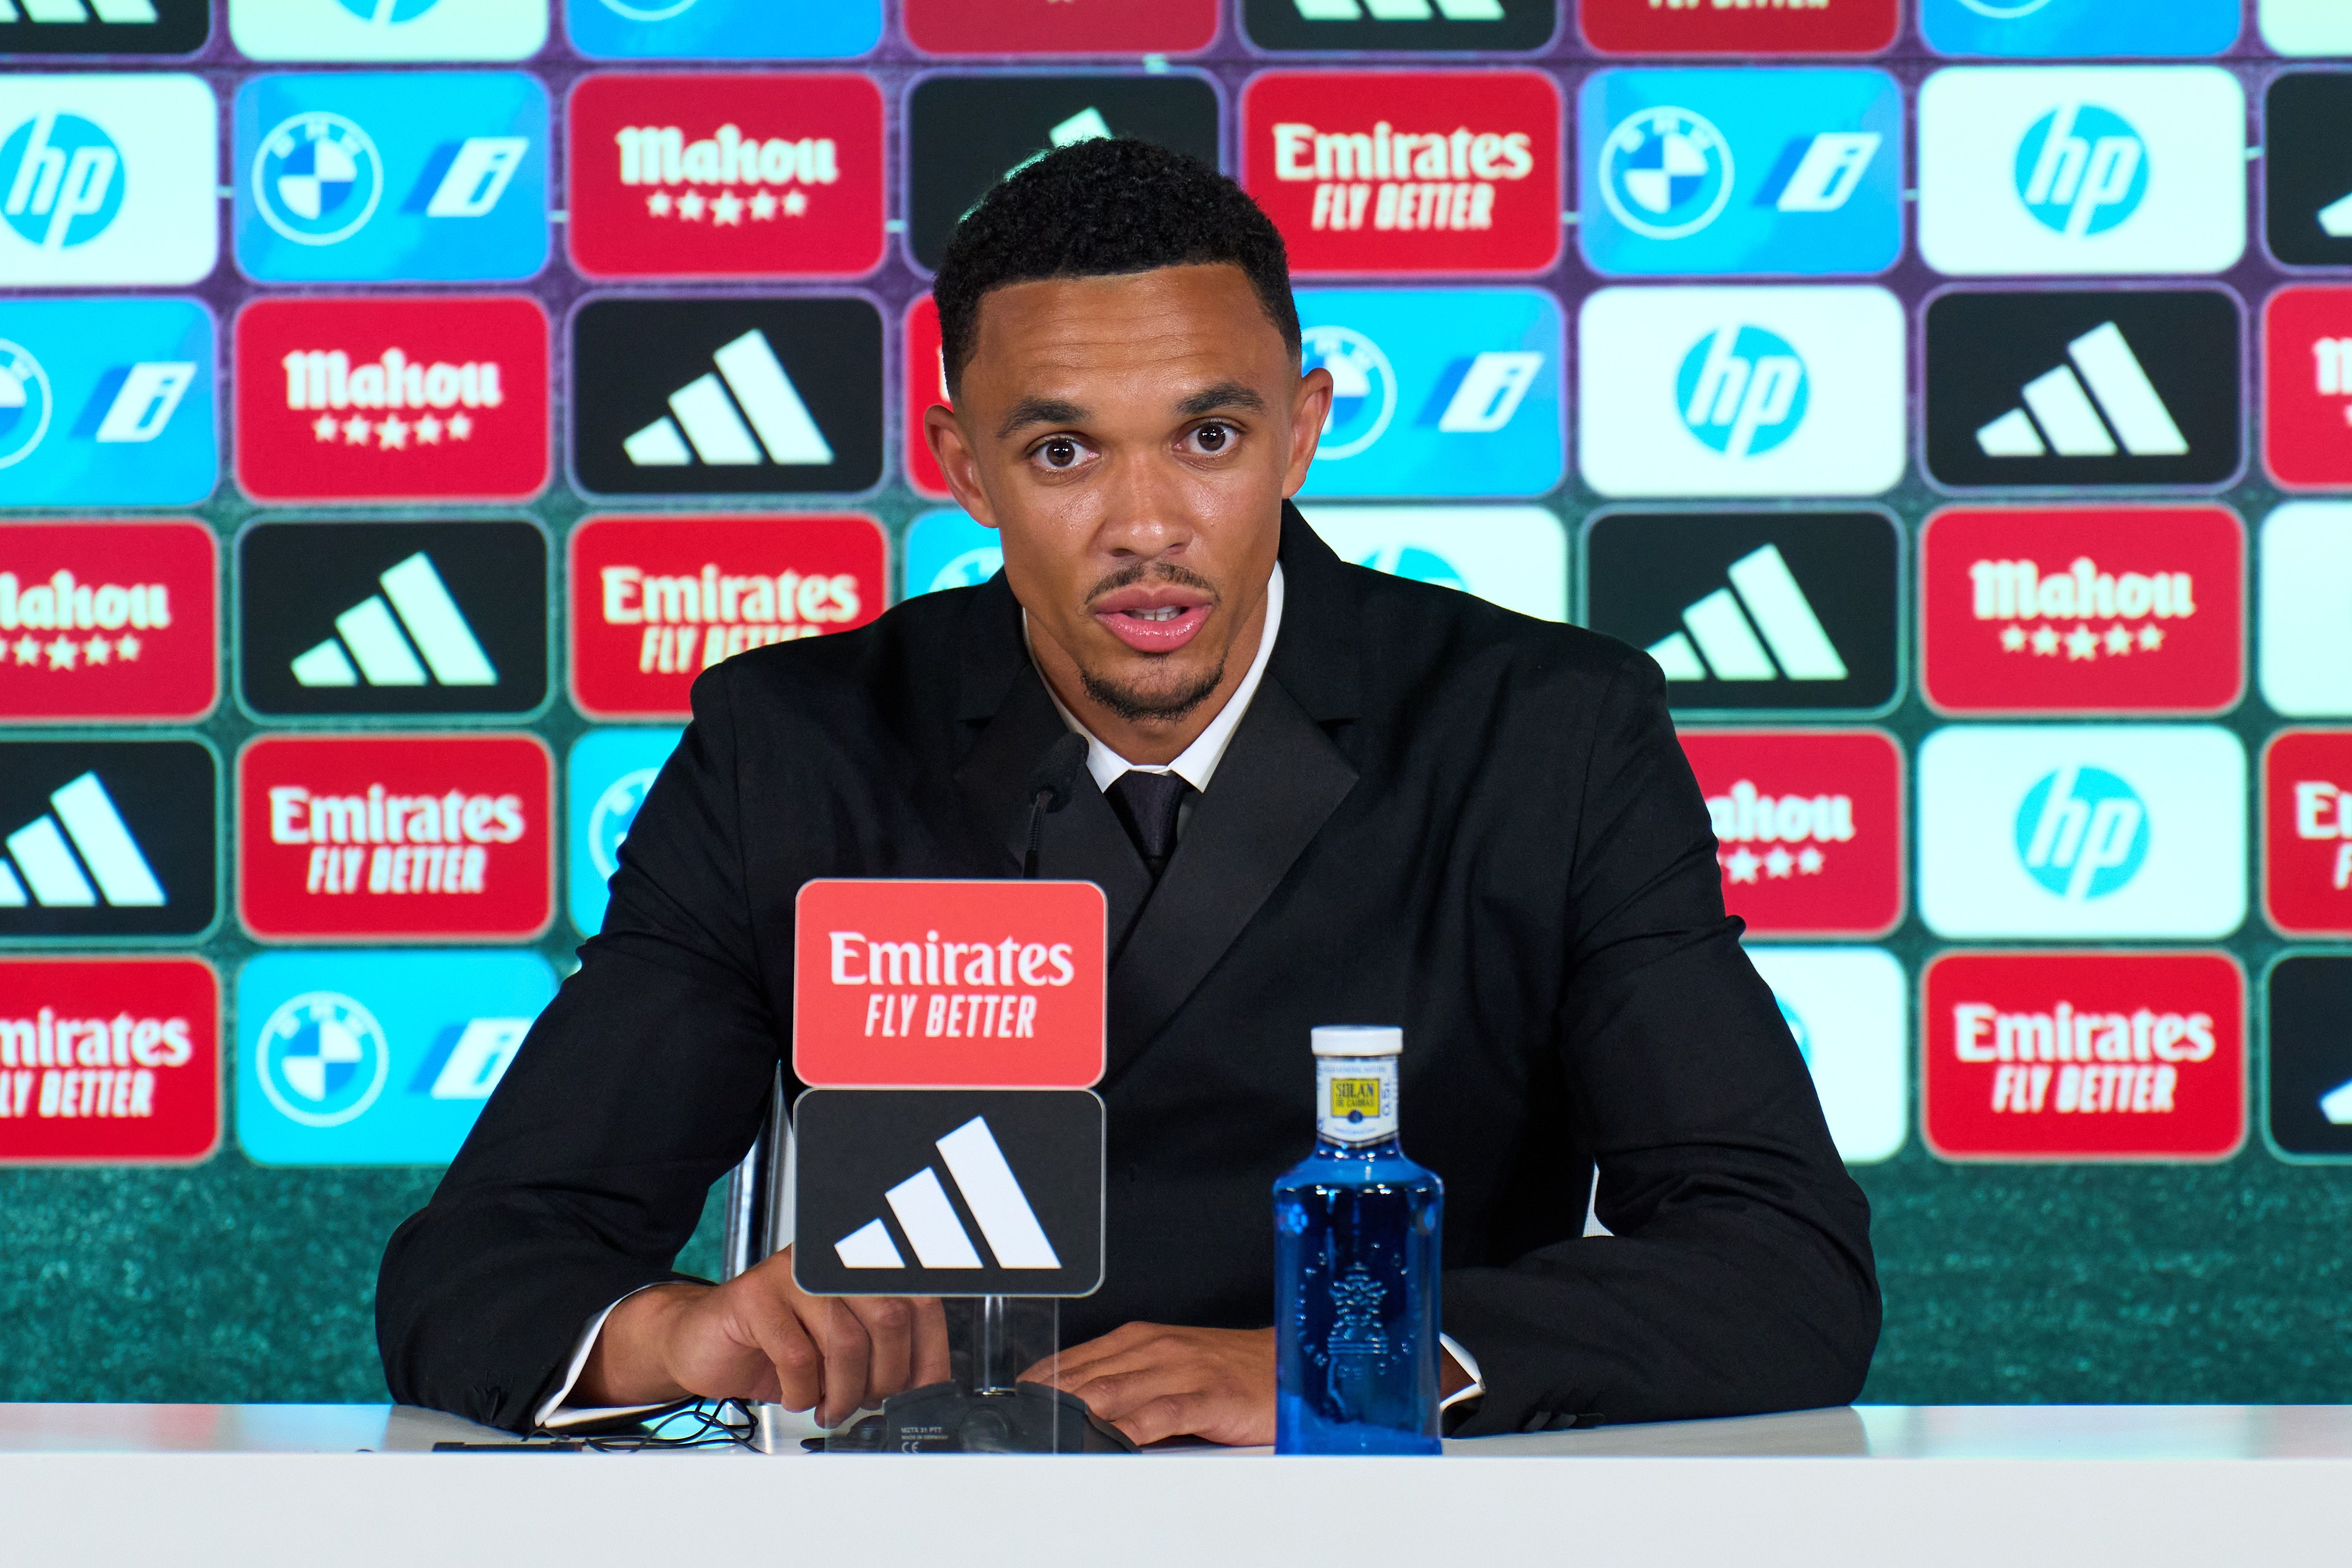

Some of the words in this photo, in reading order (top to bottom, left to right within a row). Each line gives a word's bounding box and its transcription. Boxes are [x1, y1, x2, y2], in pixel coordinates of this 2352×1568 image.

[4, 110, 119, 249] hp
[615, 123, 839, 185] Mahou
[1272, 121, 1534, 181] Emirates
[2023, 101, 2141, 238] hp
[1311, 181, 1371, 231] FLY
[1374, 181, 1495, 231] BETTER
[282, 347, 503, 410] Mahou
[1684, 322, 1802, 458] hp
[0, 569, 171, 631] ahou
[601, 563, 860, 624] Emirates
[1968, 556, 2196, 621] Mahou
[638, 625, 698, 674] FLY
[269, 784, 525, 845] Emirates
[2024, 762, 2141, 902] hp
[306, 845, 365, 894] FLY
[368, 845, 487, 894] BETTER
[828, 929, 1075, 987] Emirates
[864, 993, 919, 1039] FLY
[924, 993, 1038, 1039] BETTER
[1953, 1002, 2216, 1063] Emirates
[38, 1069, 155, 1118] BETTER
[1992, 1063, 2052, 1113] FLY
[2055, 1063, 2178, 1113] BETTER
